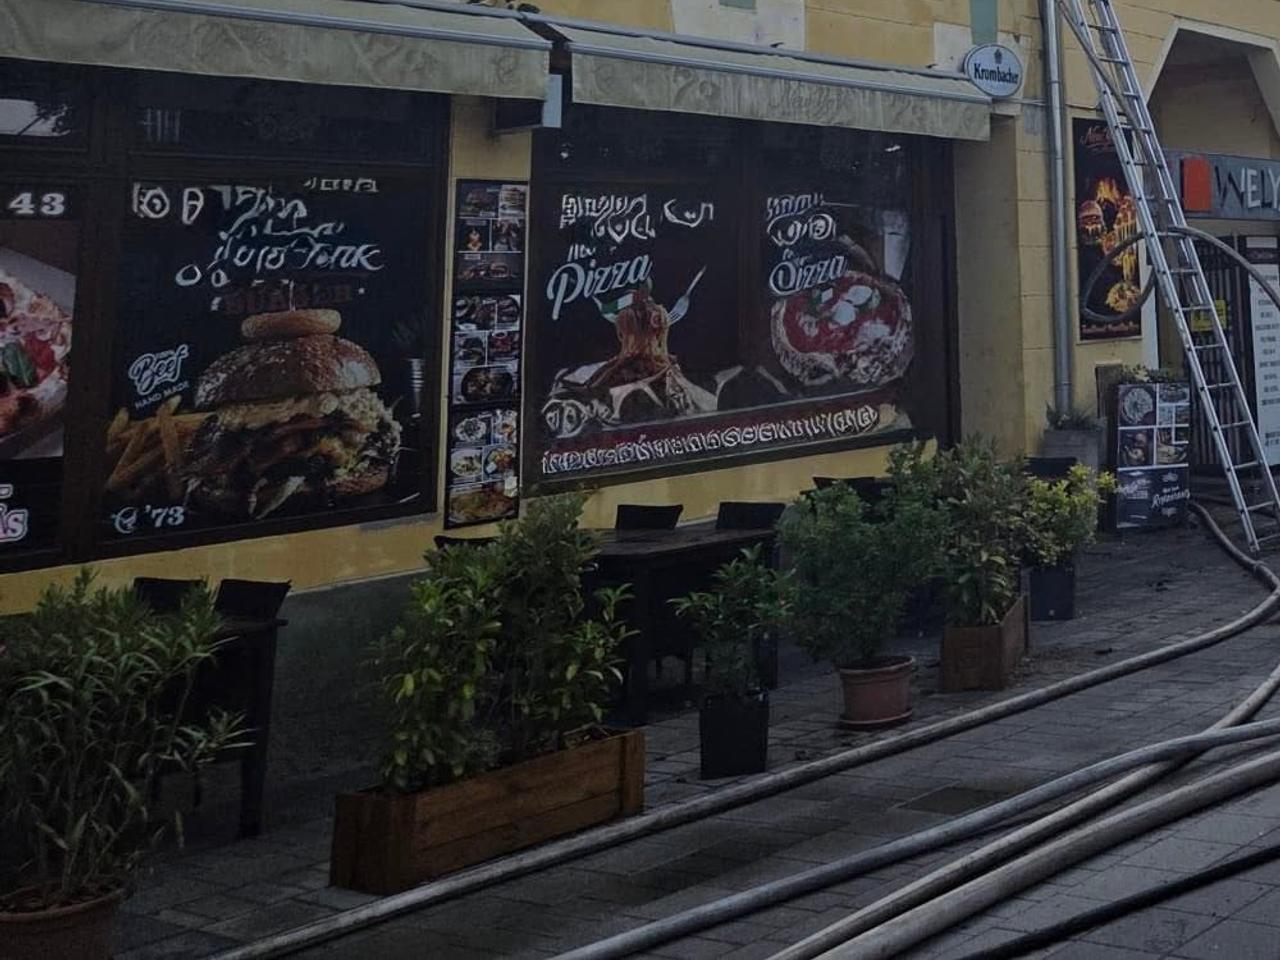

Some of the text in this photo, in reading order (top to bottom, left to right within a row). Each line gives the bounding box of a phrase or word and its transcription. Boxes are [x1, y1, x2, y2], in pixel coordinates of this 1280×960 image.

[973, 63, 1019, 85] Krombacher
[547, 254, 653, 321] Pizza
[128, 344, 190, 396] Beef
[135, 393, 162, 411] HAND
